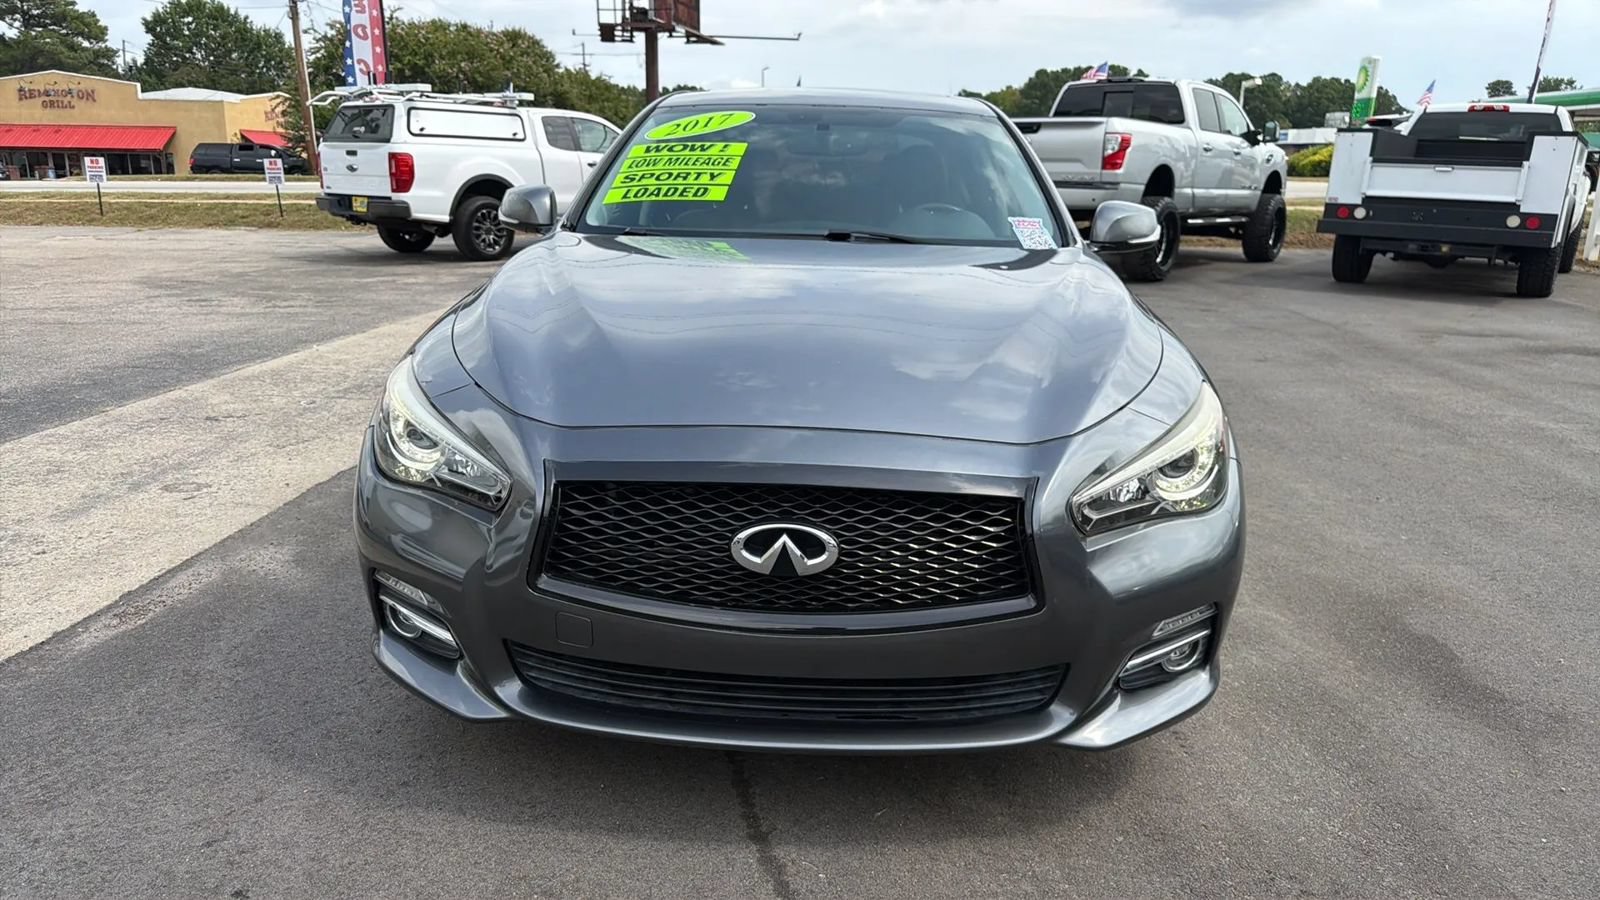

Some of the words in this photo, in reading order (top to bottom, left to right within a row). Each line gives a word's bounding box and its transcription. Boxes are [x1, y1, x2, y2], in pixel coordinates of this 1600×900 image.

[41, 100, 75, 109] GRILL
[664, 113, 733, 137] 2017
[628, 158, 662, 169] LOW
[663, 156, 733, 168] MILEAGE
[620, 172, 723, 184] SPORTY
[621, 187, 710, 200] LOADED
